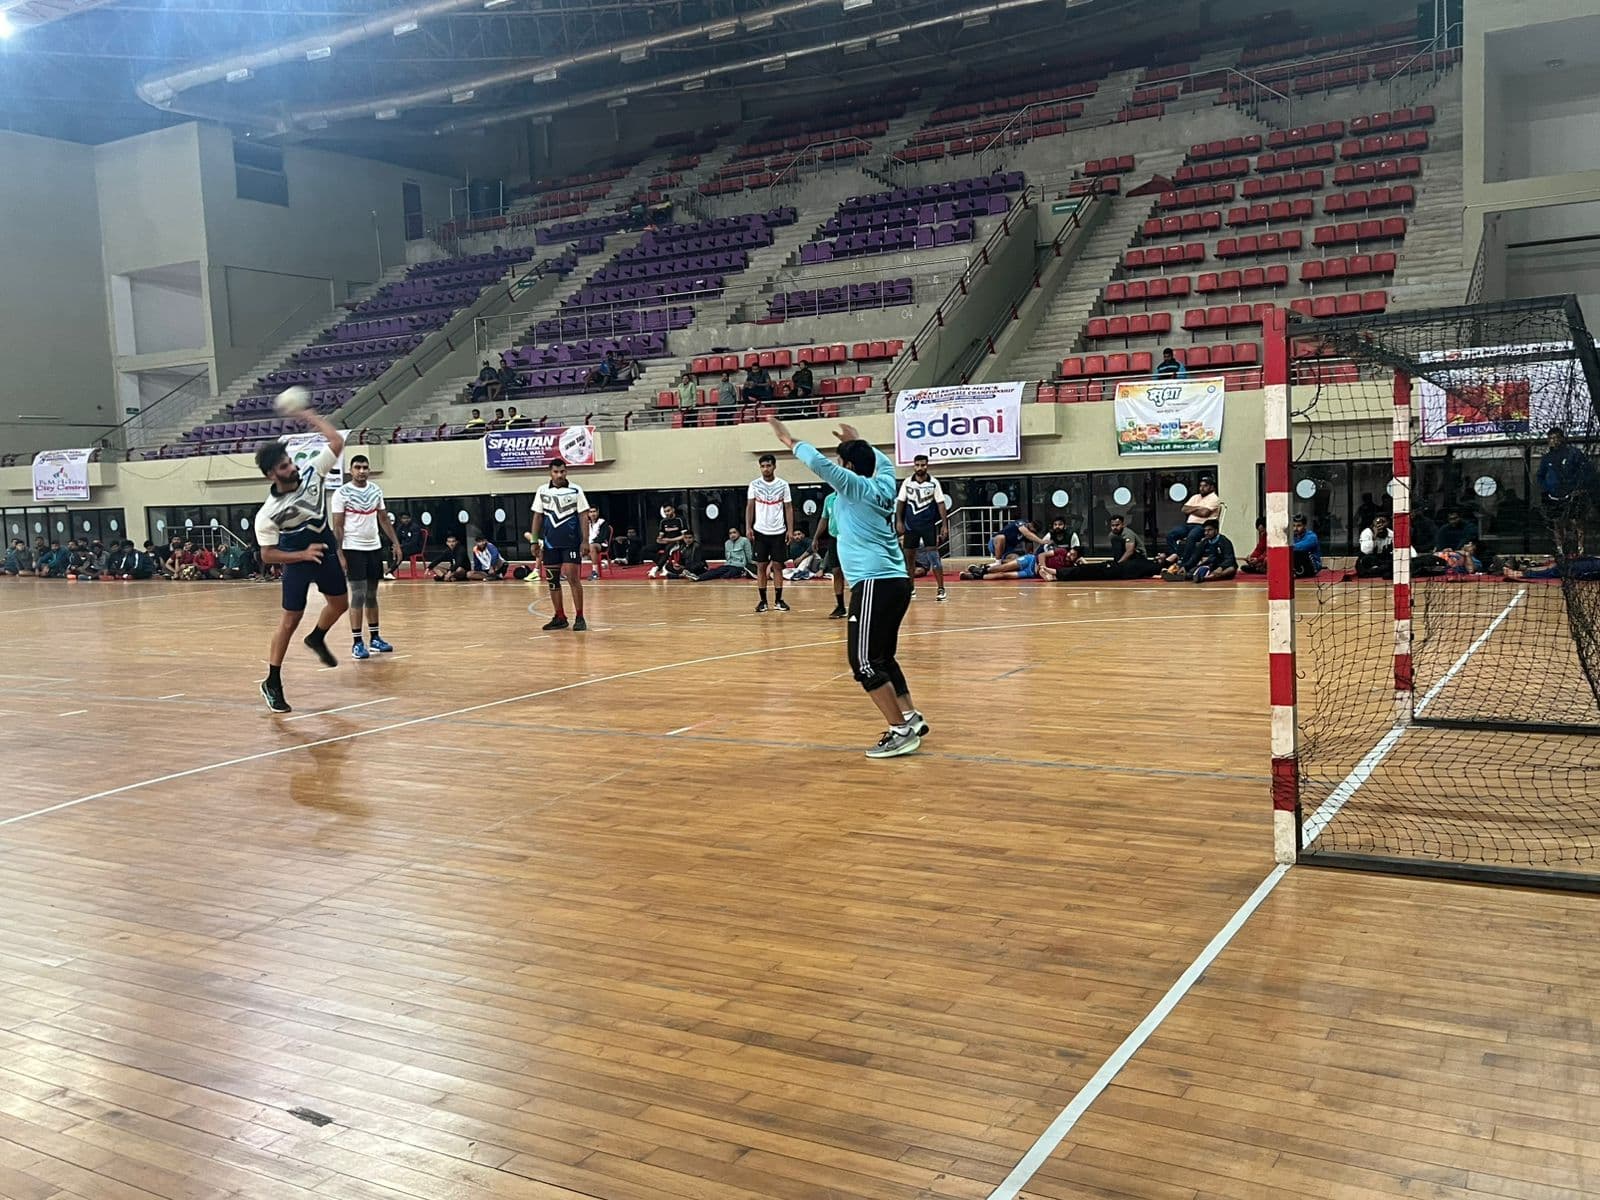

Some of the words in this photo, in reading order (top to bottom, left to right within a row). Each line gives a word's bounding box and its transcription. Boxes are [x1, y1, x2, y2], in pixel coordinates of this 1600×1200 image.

[906, 409, 1004, 439] adani
[488, 436, 554, 449] SPARTAN
[929, 446, 981, 457] Power
